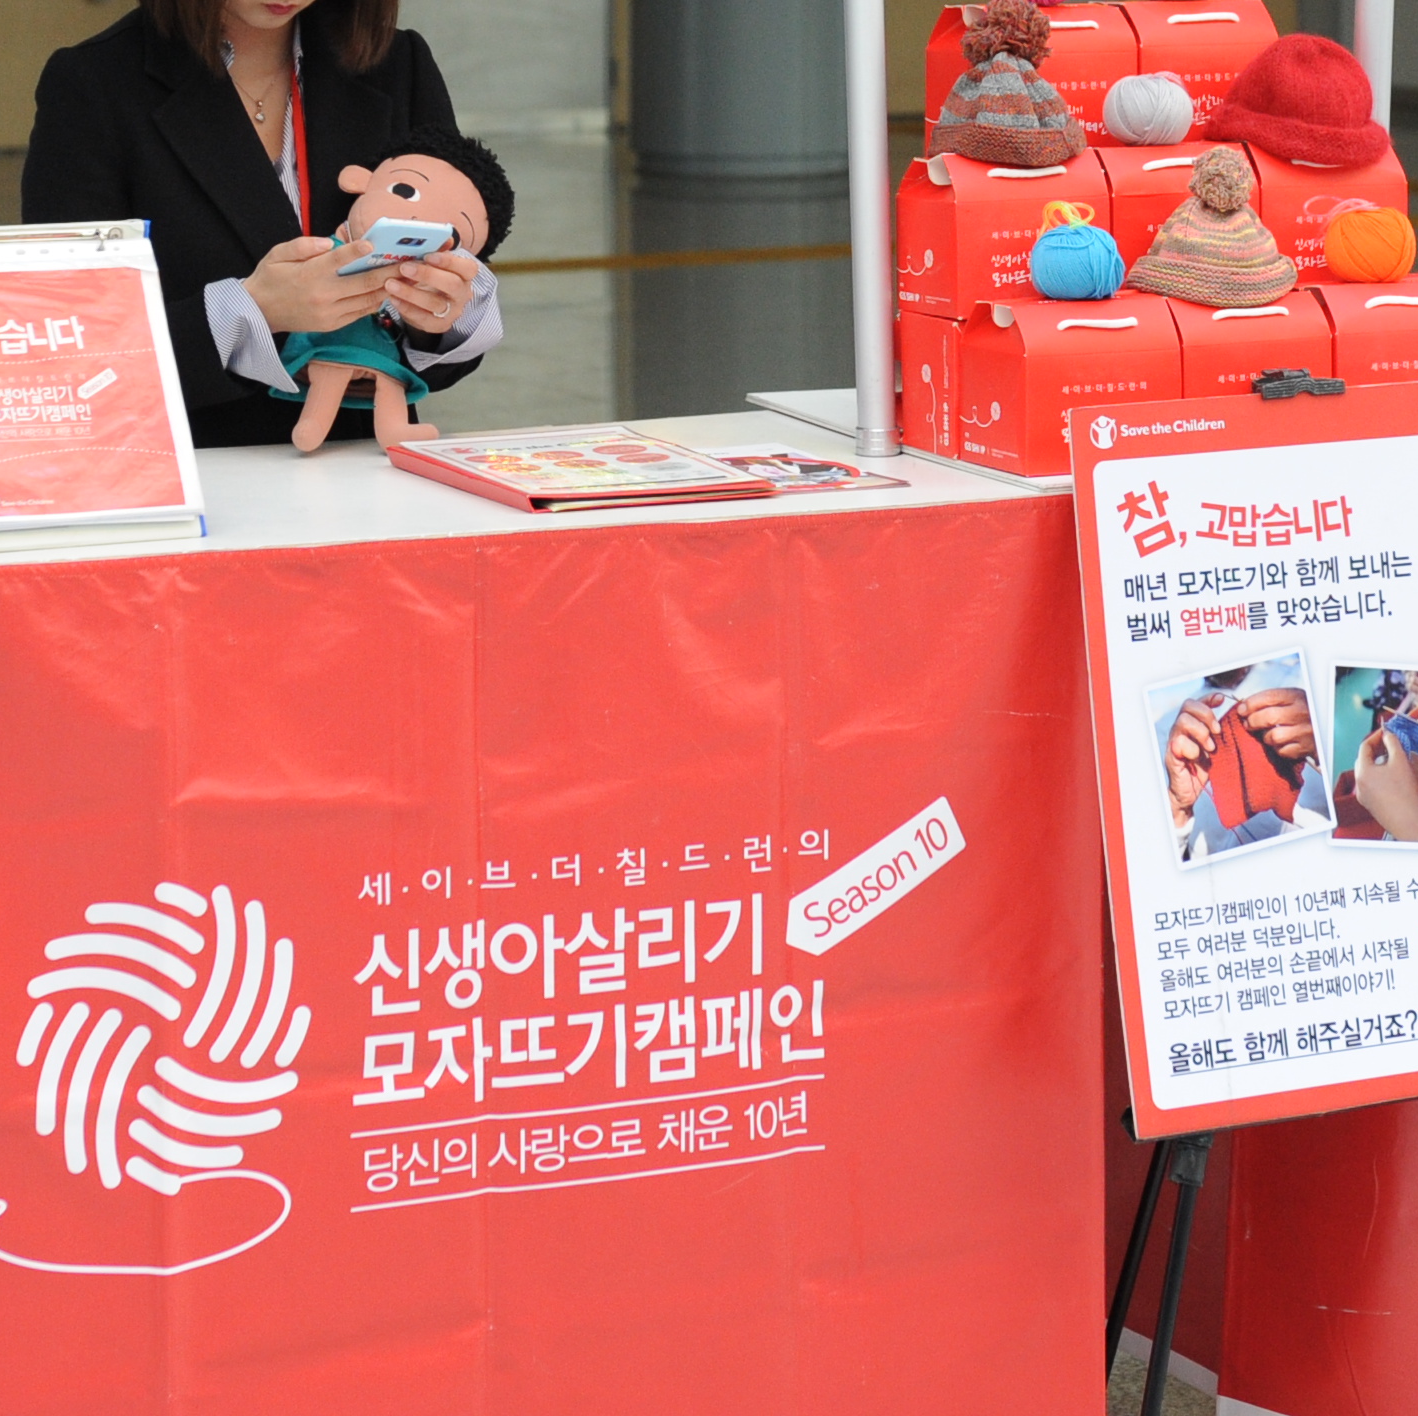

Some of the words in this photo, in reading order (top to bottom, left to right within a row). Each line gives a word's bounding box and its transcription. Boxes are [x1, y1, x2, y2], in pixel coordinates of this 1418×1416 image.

[1120, 424, 1150, 437] Save
[1151, 422, 1172, 435] the
[1173, 418, 1226, 433] Children
[1116, 480, 1189, 558] 참,
[1196, 495, 1353, 548] 고맙습니다
[1124, 572, 1168, 603] 매년
[1177, 561, 1288, 599] 모자뜨기와
[1295, 555, 1340, 586] 함께
[1347, 550, 1413, 581] 보내는
[1127, 612, 1172, 642] 벌써
[1179, 600, 1269, 637] 열번째를
[1277, 589, 1393, 627] 맞았습니다.
[802, 848, 918, 939] Season
[913, 816, 950, 863] 10
[1154, 892, 1288, 932] 모자뜨기캠페인이
[1293, 886, 1346, 916] 10년째
[1352, 879, 1401, 907] 지속될
[353, 892, 764, 1017] 신생아살리기
[1156, 938, 1189, 961] 모두
[1197, 928, 1247, 956] 여러분
[1253, 917, 1341, 951] 덕분입니다.
[1159, 964, 1211, 993] 올해도
[1217, 955, 1284, 985] 여러분의
[1289, 947, 1355, 976] 손끝에서
[1361, 936, 1410, 962] 시작될
[1163, 990, 1231, 1021] 모자뜨기
[1236, 984, 1287, 1012] 캠페인
[1293, 969, 1396, 1004] 열번째이야기!
[351, 980, 826, 1107] 모자뜨기캠페인
[1168, 1036, 1237, 1074] 올해도
[1245, 1028, 1289, 1064] 함께
[1296, 1009, 1418, 1054] 해주실거죠?
[363, 1133, 478, 1193] 당신의
[487, 1119, 646, 1175] 사랑으로
[657, 1105, 733, 1154] 채운
[743, 1090, 809, 1141] 10년
